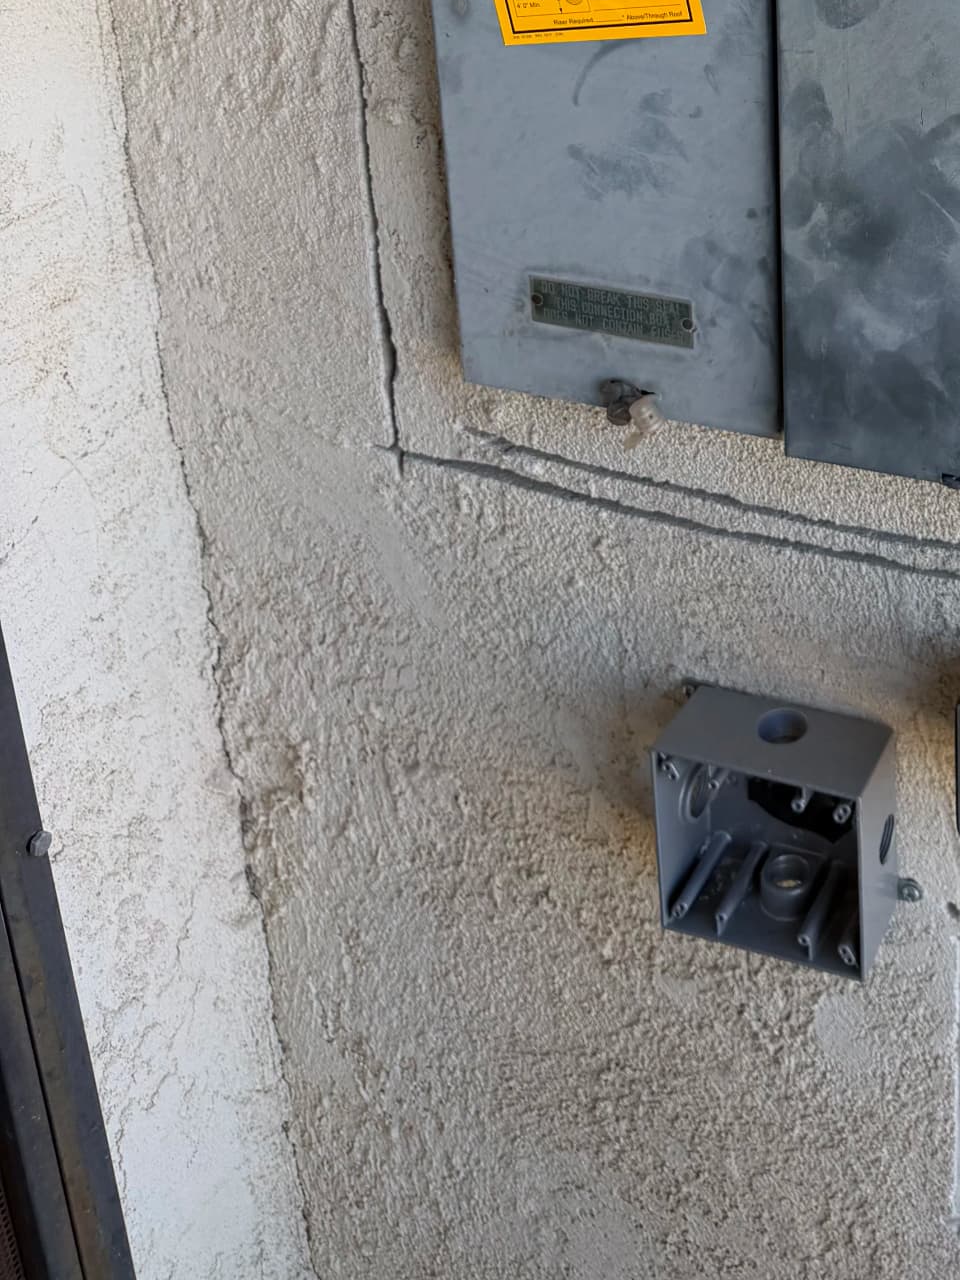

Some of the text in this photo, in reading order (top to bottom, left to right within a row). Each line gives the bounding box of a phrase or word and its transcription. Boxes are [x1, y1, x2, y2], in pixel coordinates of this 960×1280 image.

[568, 16, 594, 26] Required
[541, 280, 555, 294] DO
[561, 283, 581, 299] NOT
[586, 288, 621, 306] BREAK
[626, 295, 650, 311] THIS
[556, 295, 577, 312] THIS
[581, 301, 644, 325] CONNECTION
[575, 312, 594, 327] NOT
[602, 318, 644, 337] CONTAIN
